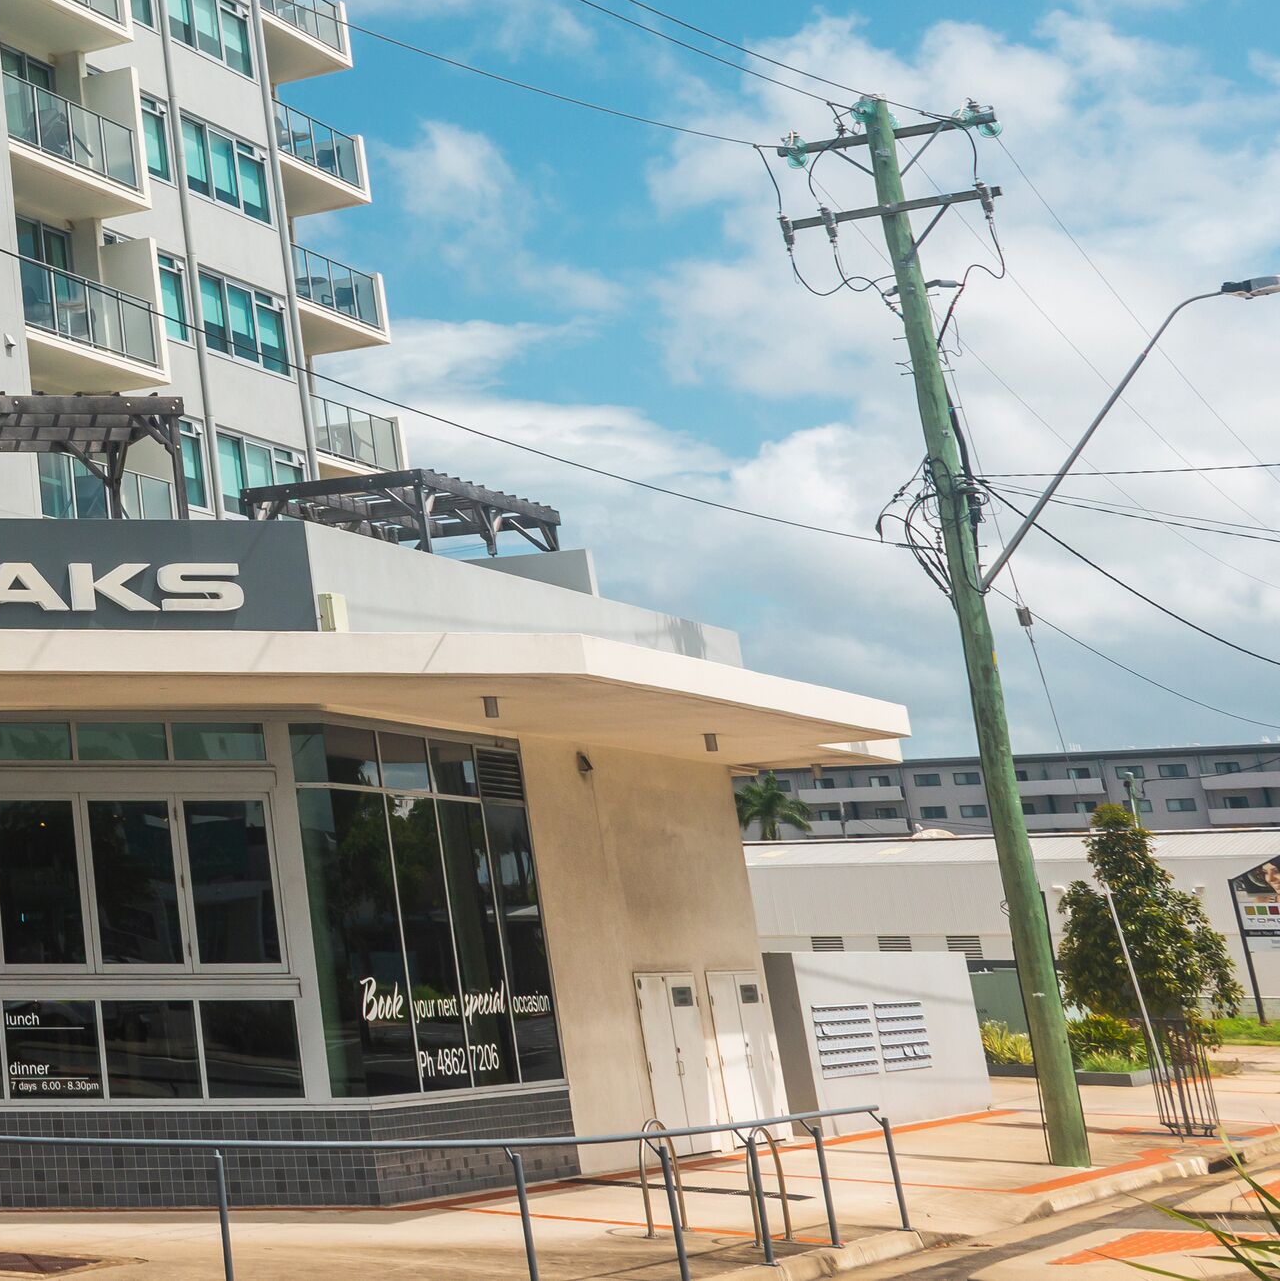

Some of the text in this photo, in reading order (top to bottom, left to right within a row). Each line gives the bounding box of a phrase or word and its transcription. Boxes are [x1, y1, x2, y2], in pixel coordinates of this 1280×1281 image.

[360, 976, 551, 1025] Book your next special occasion
[5, 1012, 40, 1026] lunch
[419, 1043, 500, 1078] Ph 4862 7206
[9, 1061, 50, 1075] dinner
[10, 1081, 17, 1090] 7
[18, 1081, 38, 1092] days
[41, 1081, 61, 1090] 6.00
[67, 1081, 99, 1092] 8.30pm
